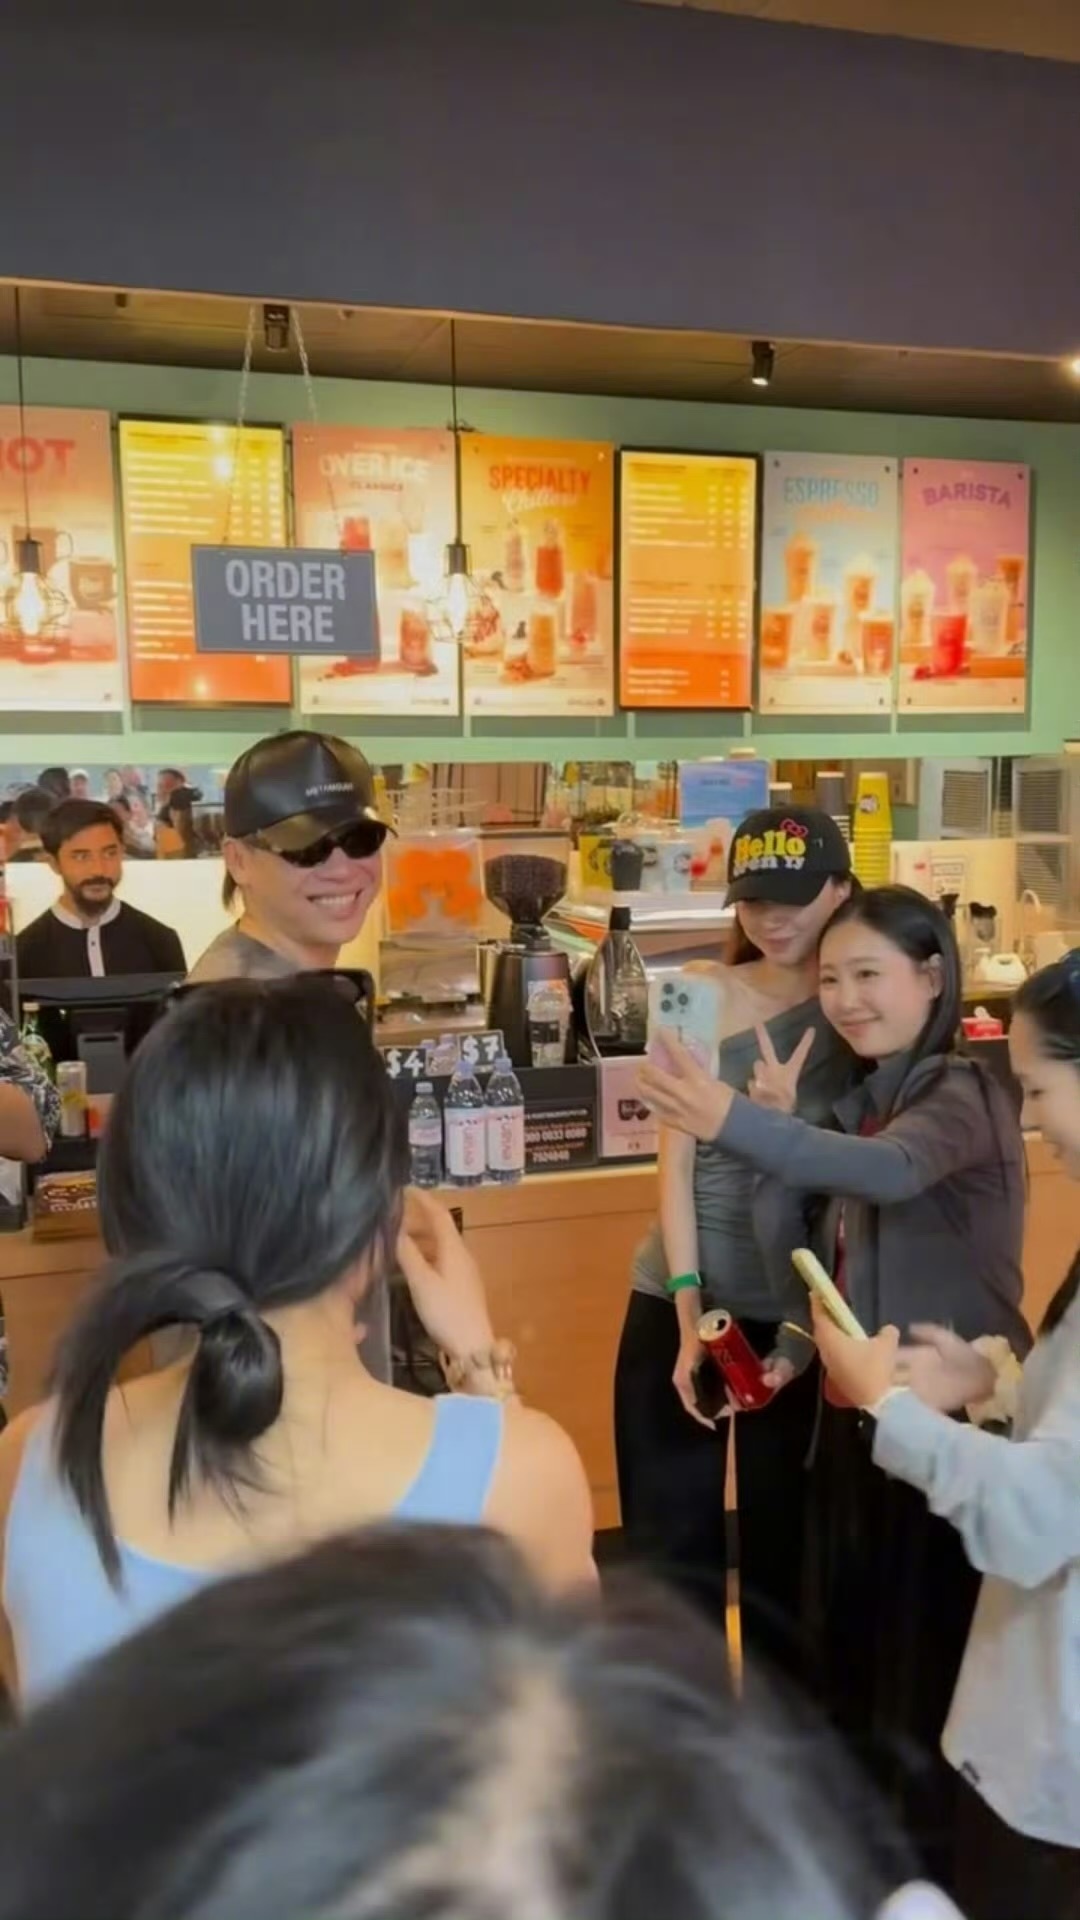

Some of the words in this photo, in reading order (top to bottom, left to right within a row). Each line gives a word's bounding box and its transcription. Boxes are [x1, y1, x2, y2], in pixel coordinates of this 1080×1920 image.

[0, 437, 75, 476] OT
[489, 464, 591, 495] SPECIALTY
[783, 477, 879, 508] ESPRESSO
[922, 482, 1011, 509] BARISTA
[225, 559, 346, 600] ORDER
[241, 604, 335, 643] HERE
[735, 830, 806, 867] Hello
[386, 1048, 424, 1079] $4
[463, 1035, 499, 1063] $7
